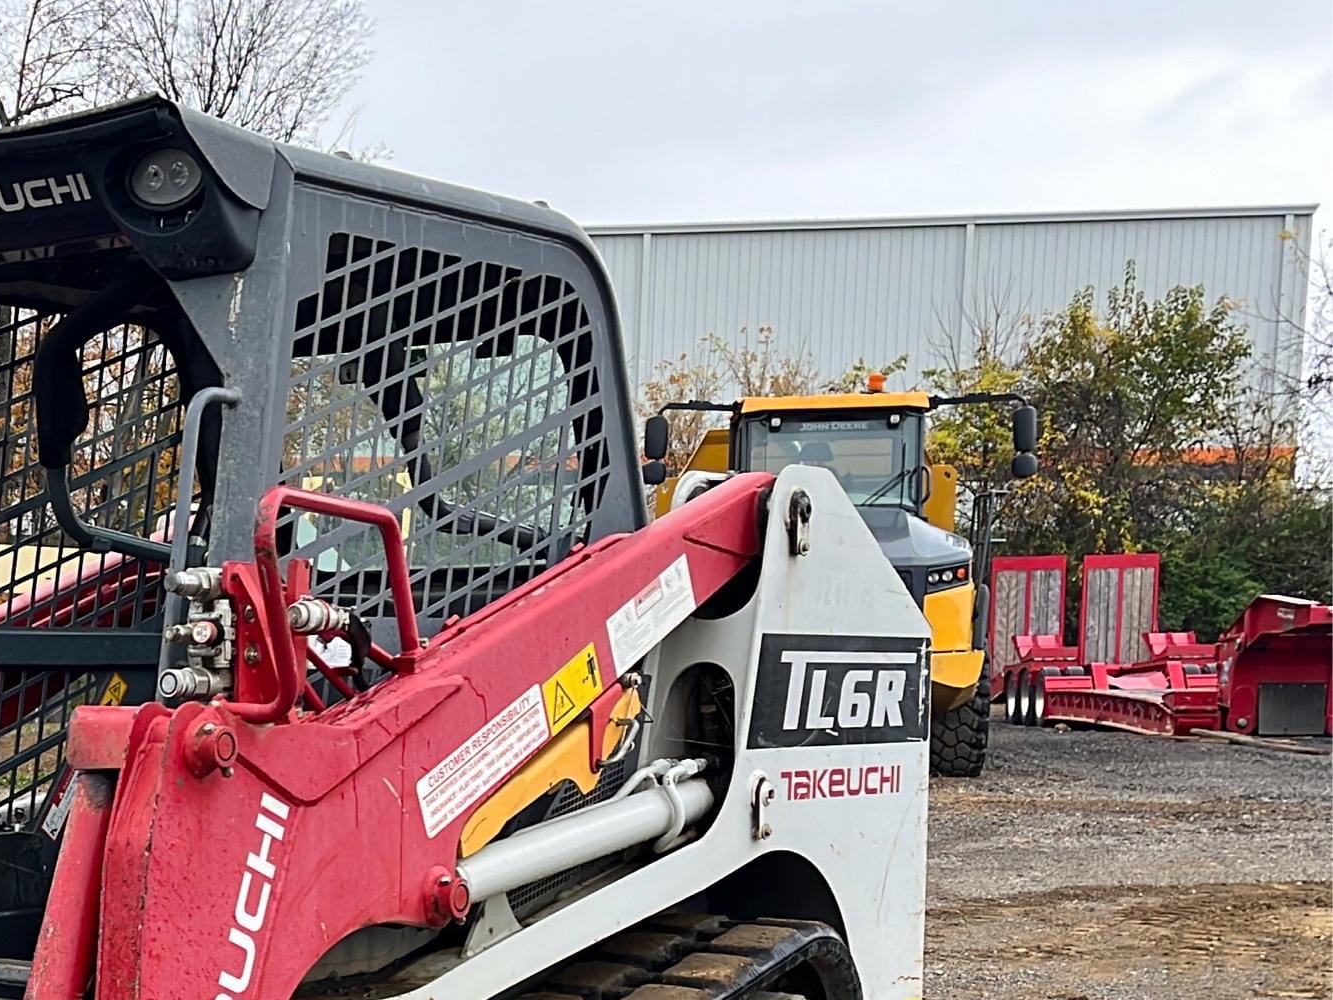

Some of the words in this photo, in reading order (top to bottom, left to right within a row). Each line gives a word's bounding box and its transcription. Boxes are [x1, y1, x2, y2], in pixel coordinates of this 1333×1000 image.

[799, 421, 829, 431] JOHN
[831, 421, 868, 430] DEERE
[780, 650, 918, 731] TL6R
[427, 744, 471, 788] CUSTOMER
[471, 694, 531, 751] RESPONSIBILITY
